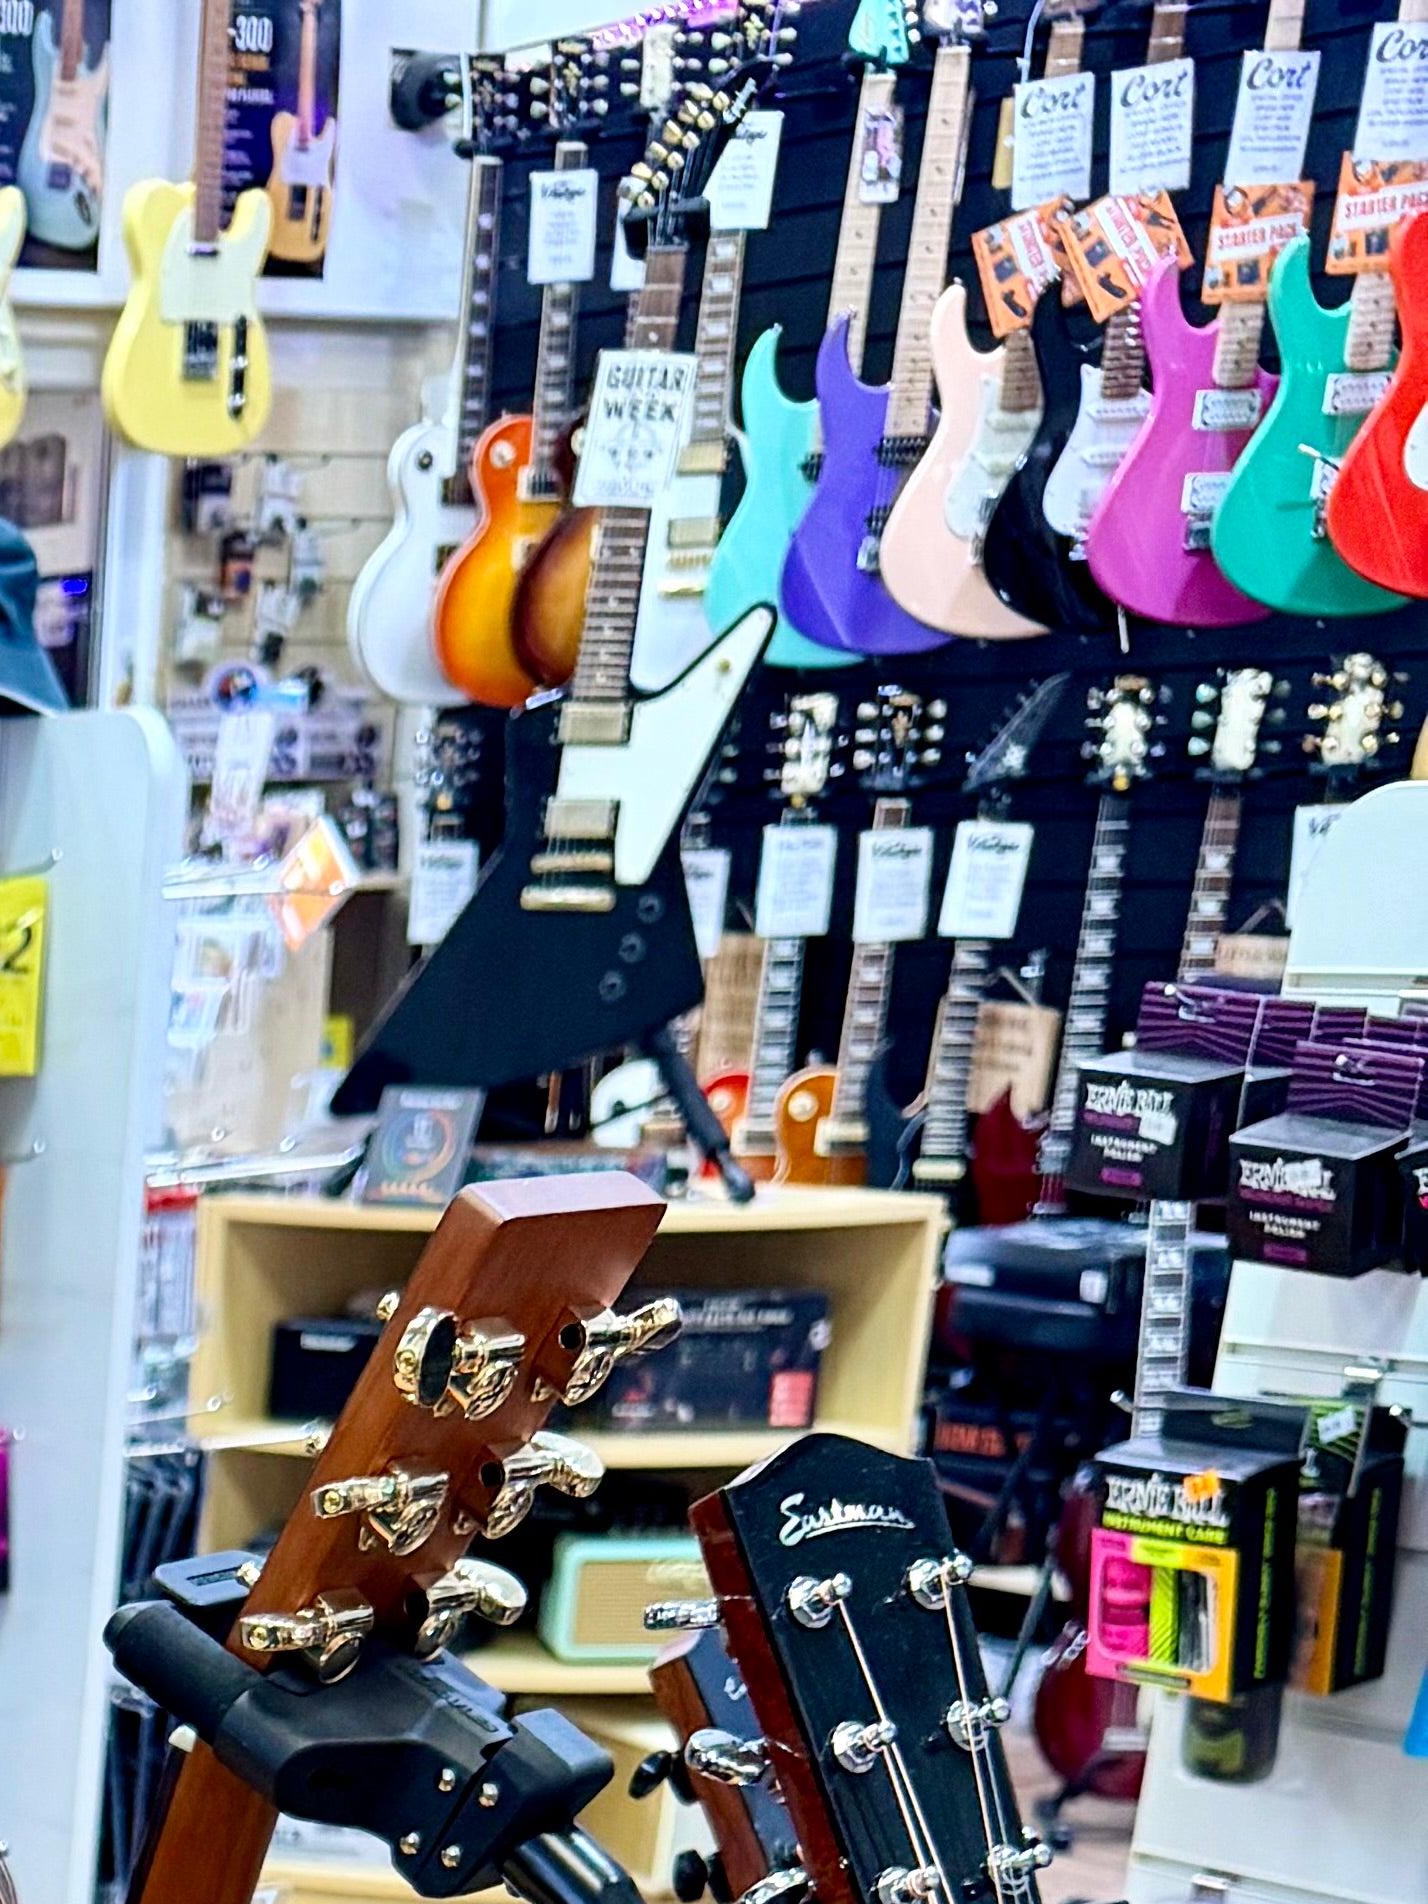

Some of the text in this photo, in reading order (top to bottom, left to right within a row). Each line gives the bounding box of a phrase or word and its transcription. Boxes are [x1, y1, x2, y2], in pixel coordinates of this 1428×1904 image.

[1120, 71, 1188, 108] Cort
[1246, 57, 1312, 90] Cort
[1021, 82, 1086, 119] Cort
[1344, 195, 1396, 219] STARTER
[1217, 226, 1266, 249] STARTER
[606, 363, 686, 391] GUITAR
[604, 398, 676, 423] WEEK
[1085, 1080, 1135, 1116] ERNIE
[1105, 1472, 1168, 1518] ERNIE
[778, 1494, 916, 1547] Eastman
